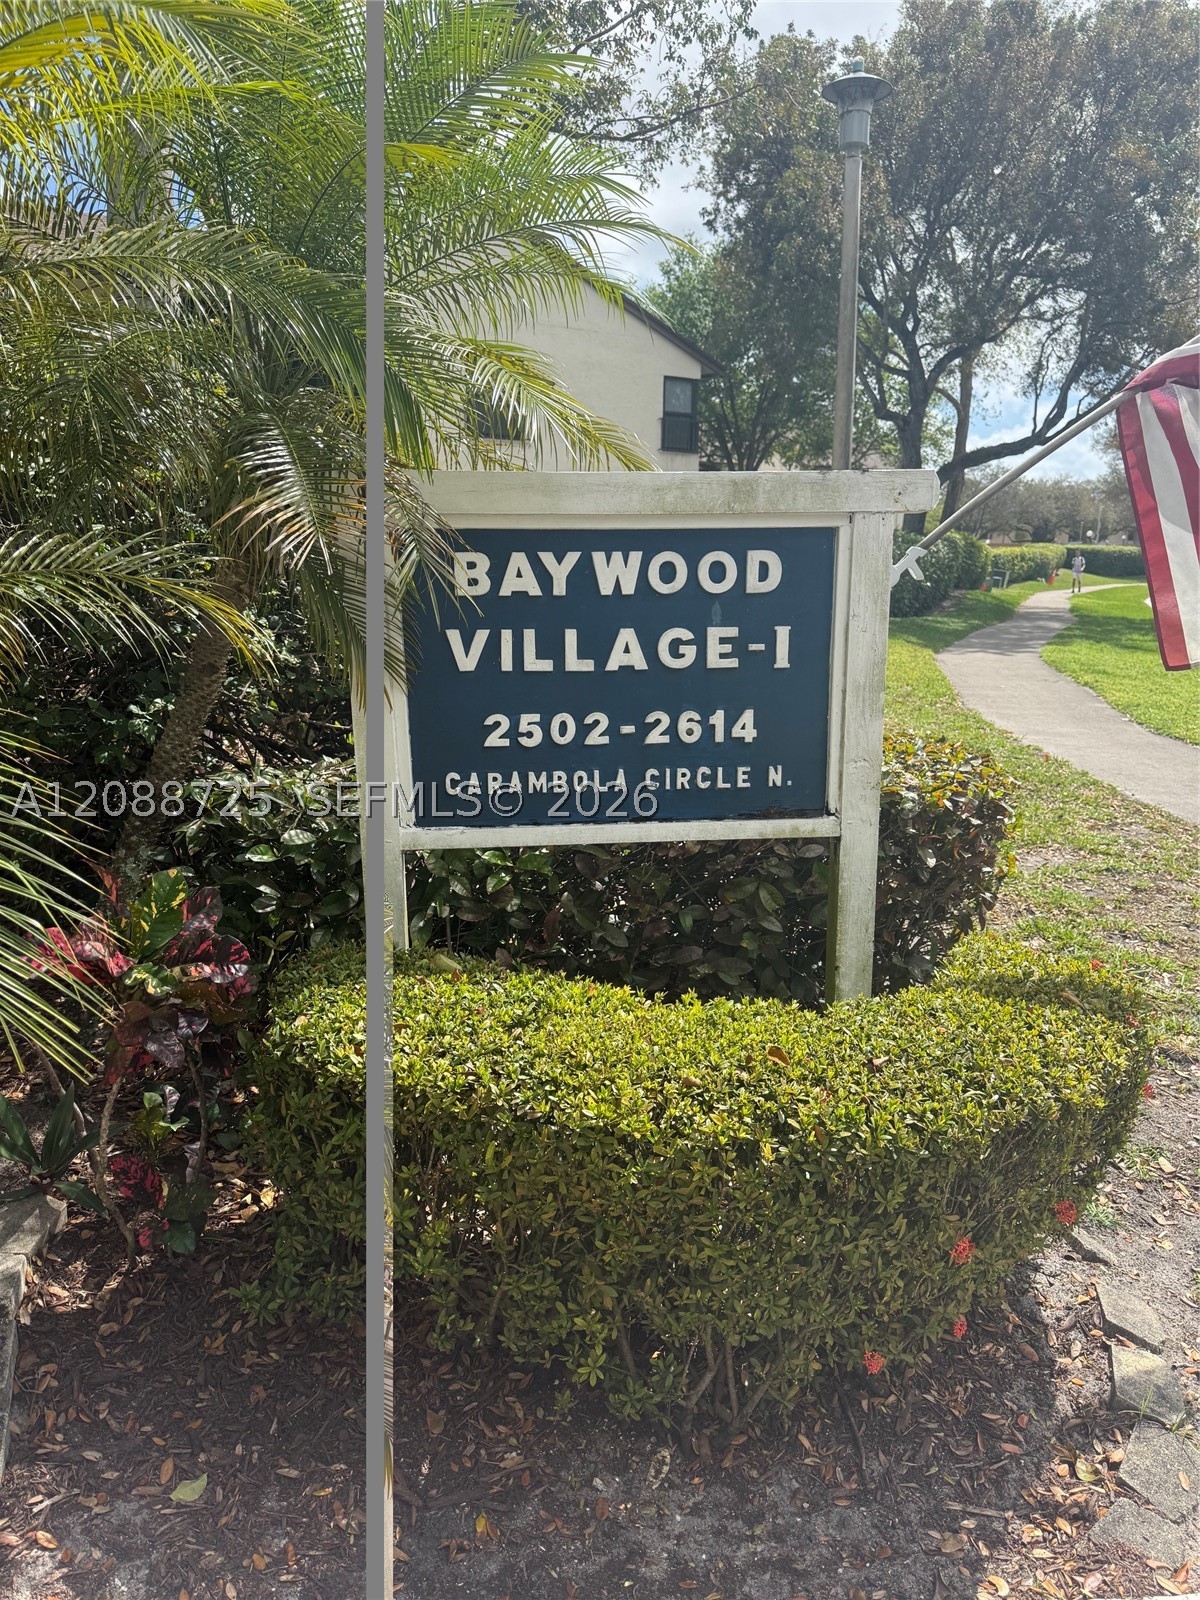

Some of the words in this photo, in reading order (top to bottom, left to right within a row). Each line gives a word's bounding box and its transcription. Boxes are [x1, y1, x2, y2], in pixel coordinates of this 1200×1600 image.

[453, 549, 783, 597] BAYWOOD
[445, 625, 792, 672] VILLAGE-I
[483, 708, 758, 749] 2502-2614
[444, 768, 626, 796] CARAMBOLA
[645, 765, 752, 792] CIRCLE
[768, 764, 793, 787] N.
